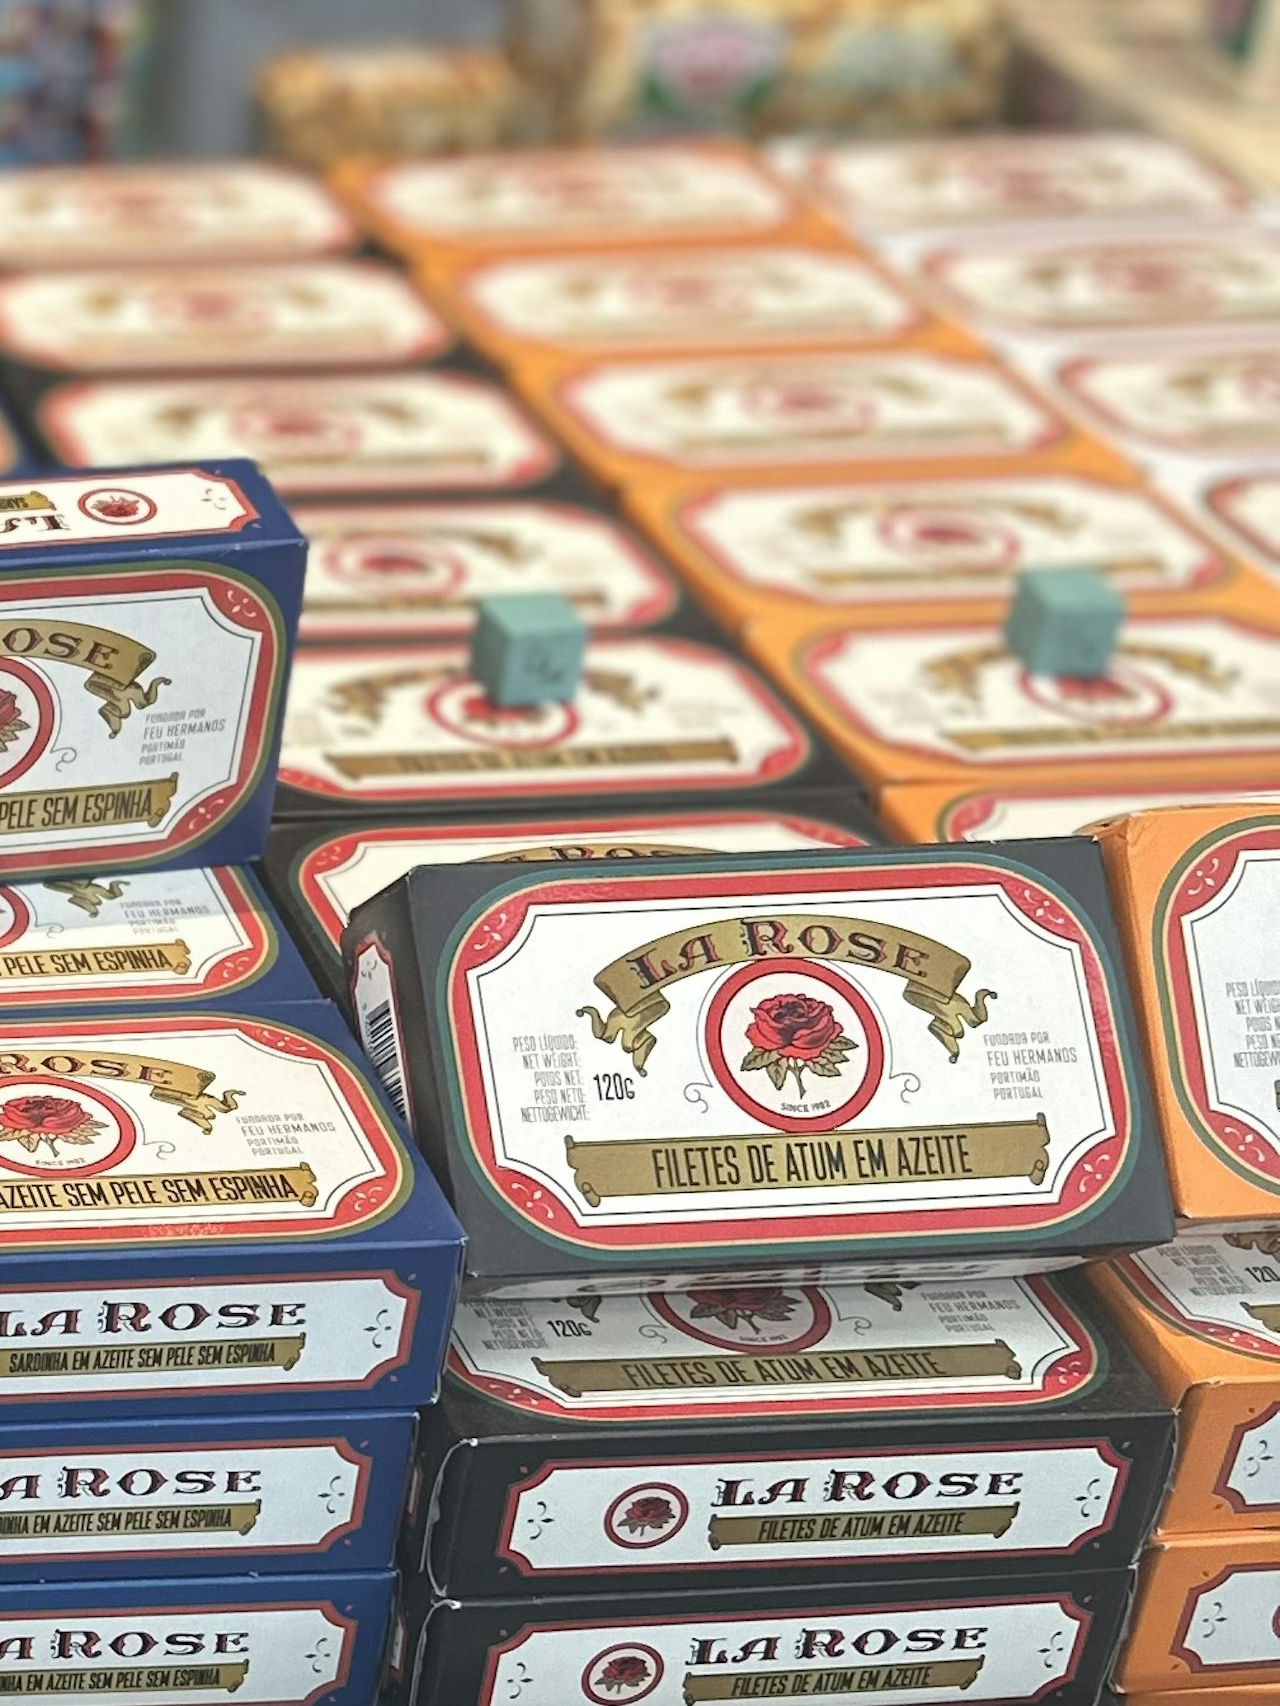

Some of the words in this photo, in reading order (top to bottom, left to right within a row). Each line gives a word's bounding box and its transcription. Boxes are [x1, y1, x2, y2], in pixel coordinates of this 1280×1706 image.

[143, 724, 163, 739] FEU
[168, 720, 226, 736] HERMANOS
[41, 800, 78, 827] SEM
[82, 790, 152, 825] ESPINHA
[631, 941, 721, 982] LA
[741, 922, 930, 977] ROSE
[987, 1051, 1009, 1066] FEU
[1012, 1047, 1077, 1065] HERMANOS
[242, 1124, 263, 1136] FEU
[653, 1147, 741, 1185] FILETES
[751, 1148, 775, 1182] DE
[786, 1145, 846, 1181] ATUM
[856, 1141, 887, 1176] EM
[896, 1137, 973, 1173] AZEITE
[67, 1183, 106, 1205] SEM
[113, 1181, 156, 1205] PELE
[162, 1179, 204, 1202] SEM
[212, 1175, 296, 1201] ESPINHA
[99, 1301, 306, 1334] ROSE
[9, 1352, 68, 1374] SARDINHA
[72, 1351, 90, 1372] EM
[94, 1350, 133, 1371] AZEITE
[138, 1349, 162, 1369] SEM
[168, 1347, 192, 1367] PELE
[198, 1346, 222, 1365] SEM
[226, 1343, 276, 1365] ESPINHA
[625, 1359, 718, 1388] FILETES
[724, 1358, 750, 1385] DE
[755, 1356, 812, 1382] ATUM
[821, 1355, 856, 1380] EM
[865, 1351, 947, 1378] AZEITE
[711, 1476, 806, 1507] LA
[822, 1469, 1023, 1502] ROSE
[757, 1518, 817, 1542] FILETES
[822, 1517, 839, 1539] DE
[843, 1515, 883, 1539] ATUM
[887, 1514, 909, 1537] EM
[914, 1512, 965, 1536] AZEITE
[51, 1629, 249, 1659] ROSE
[685, 1635, 782, 1665] LA
[795, 1627, 990, 1660] ROSE
